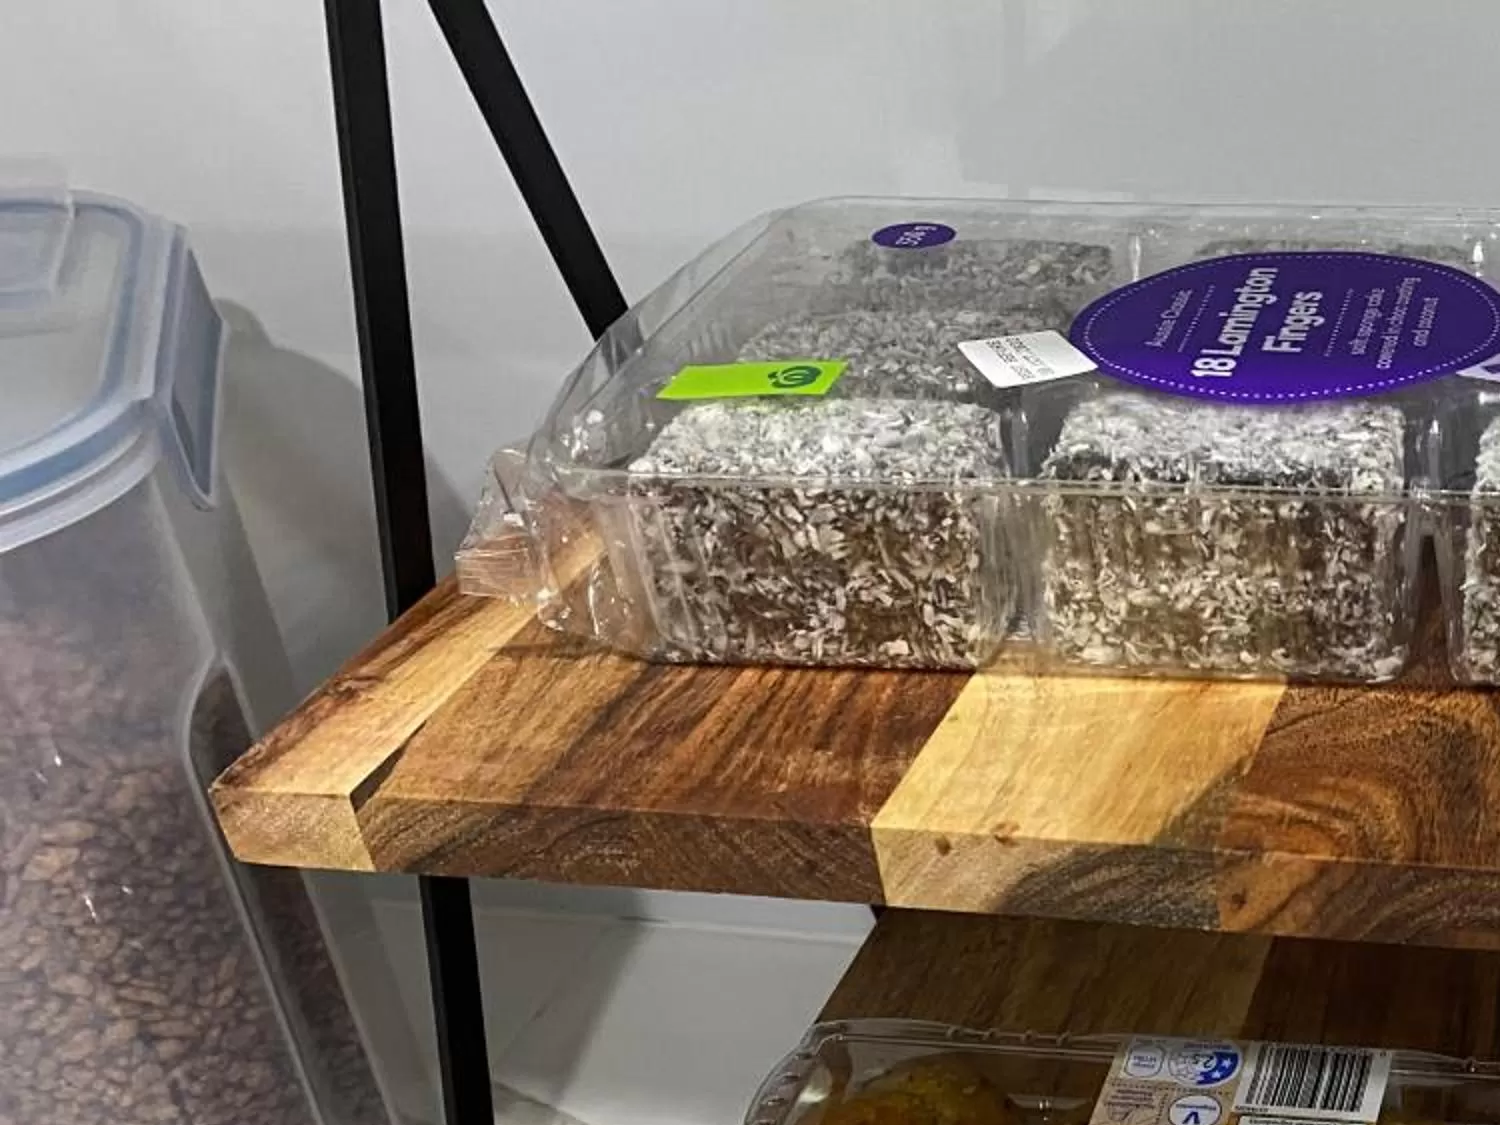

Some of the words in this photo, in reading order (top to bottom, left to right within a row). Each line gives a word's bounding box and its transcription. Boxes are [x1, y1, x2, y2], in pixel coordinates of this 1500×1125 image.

[1201, 267, 1279, 357] Lamington
[1261, 291, 1325, 353] Fingers
[1190, 356, 1237, 378] 18
[1182, 1111, 1201, 1125] V
